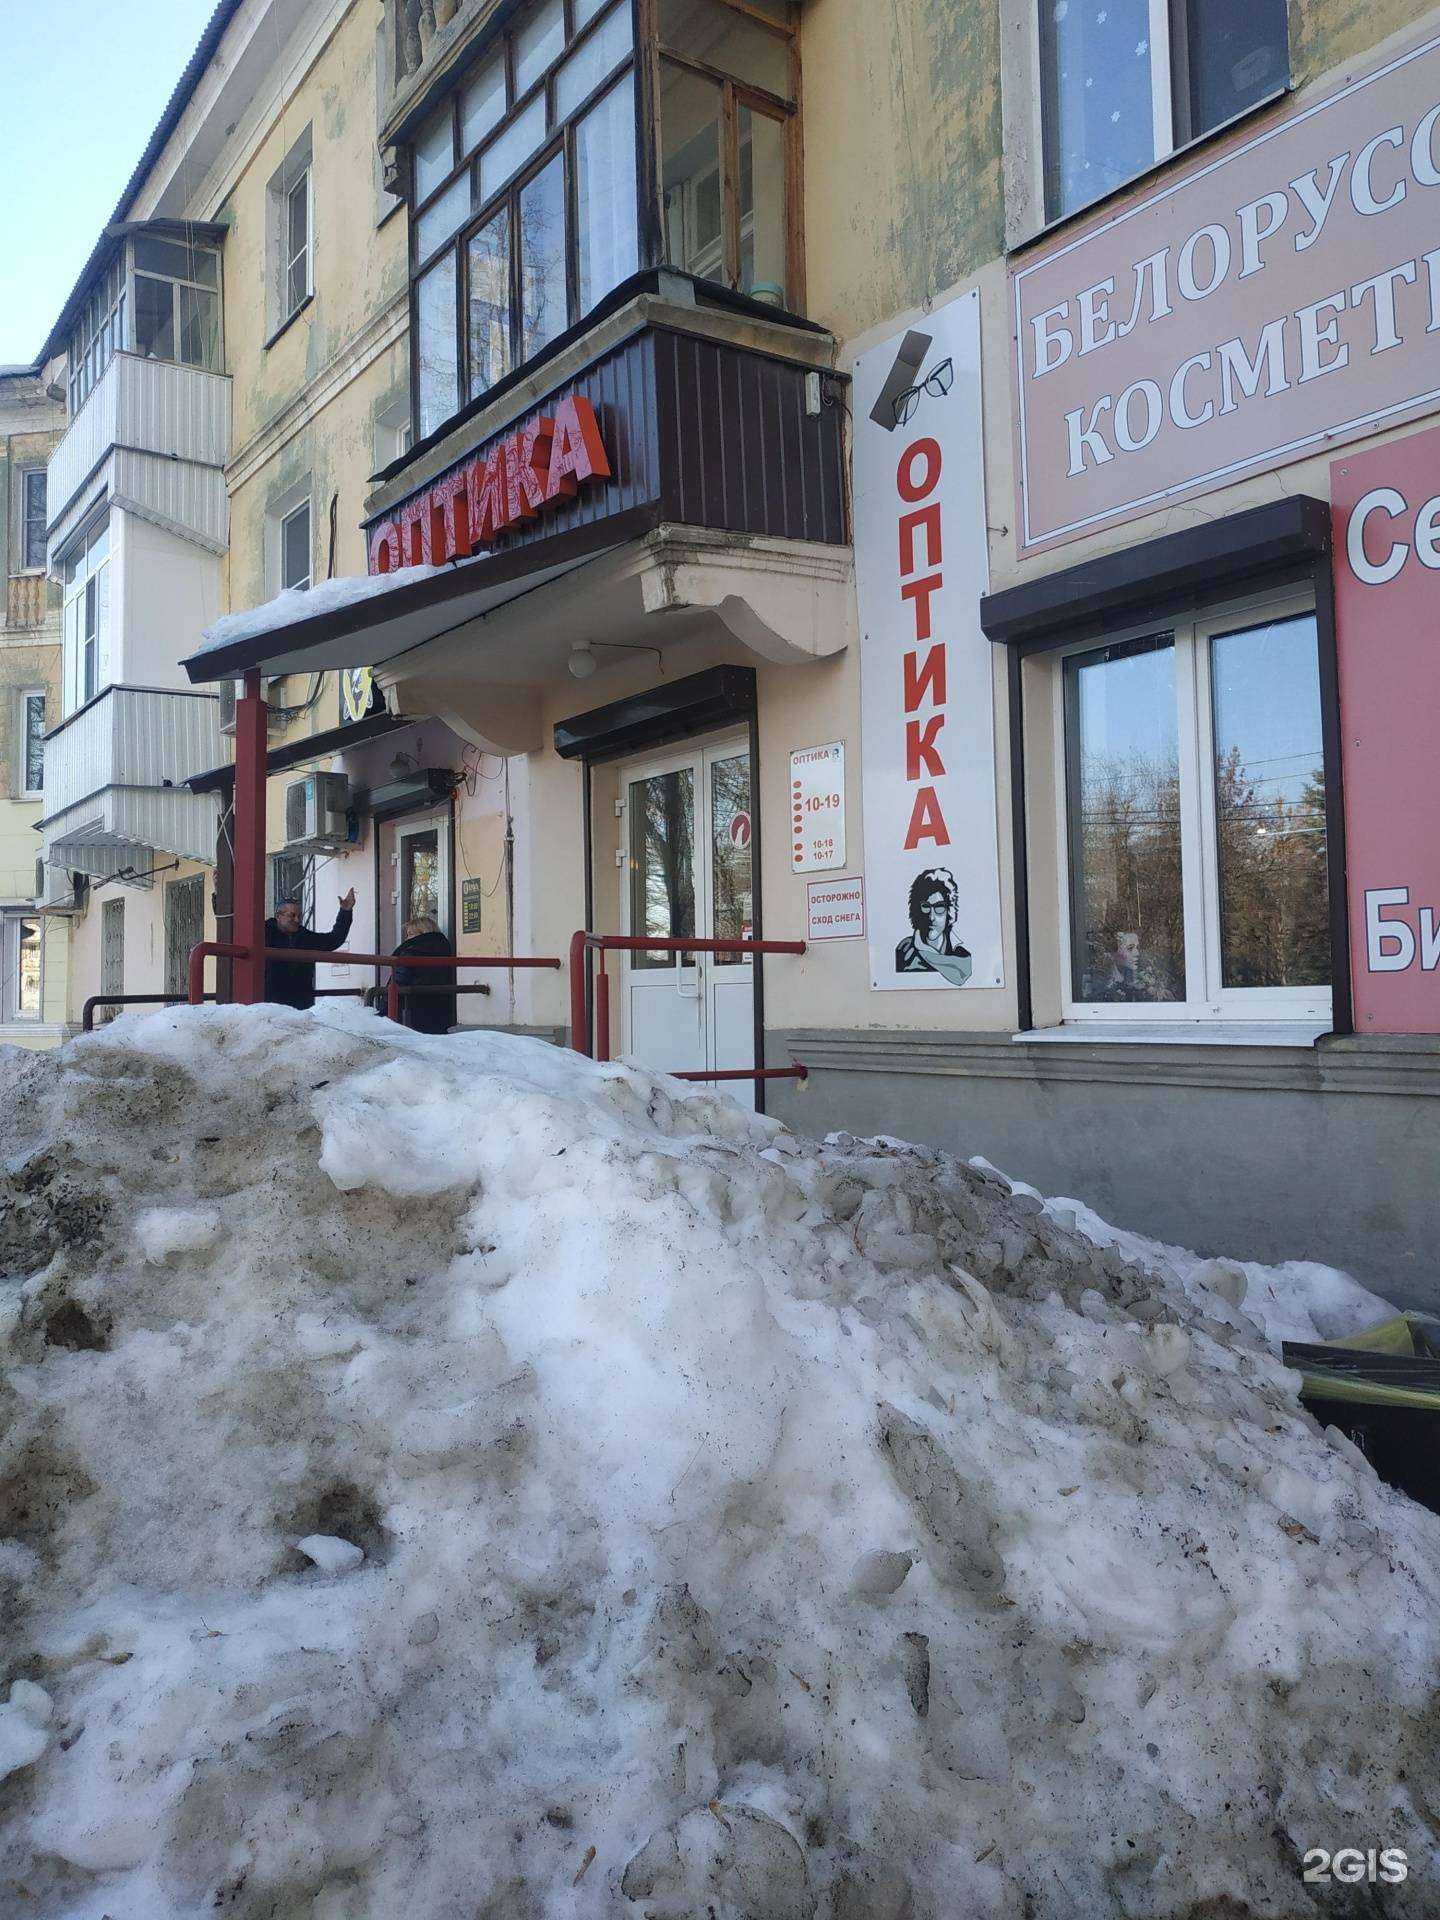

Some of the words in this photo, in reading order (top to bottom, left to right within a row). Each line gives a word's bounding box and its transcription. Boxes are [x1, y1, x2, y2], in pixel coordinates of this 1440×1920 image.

[370, 395, 611, 576] ОПТИКА
[896, 436, 951, 850] ОПТИКА
[793, 750, 829, 765] ОПТИКА
[805, 794, 840, 812] 10-19
[813, 850, 834, 861] 10-17
[811, 891, 860, 904] ОСТОРОЖНО
[811, 915, 833, 925] СХОД
[834, 912, 861, 923] СНЕГА
